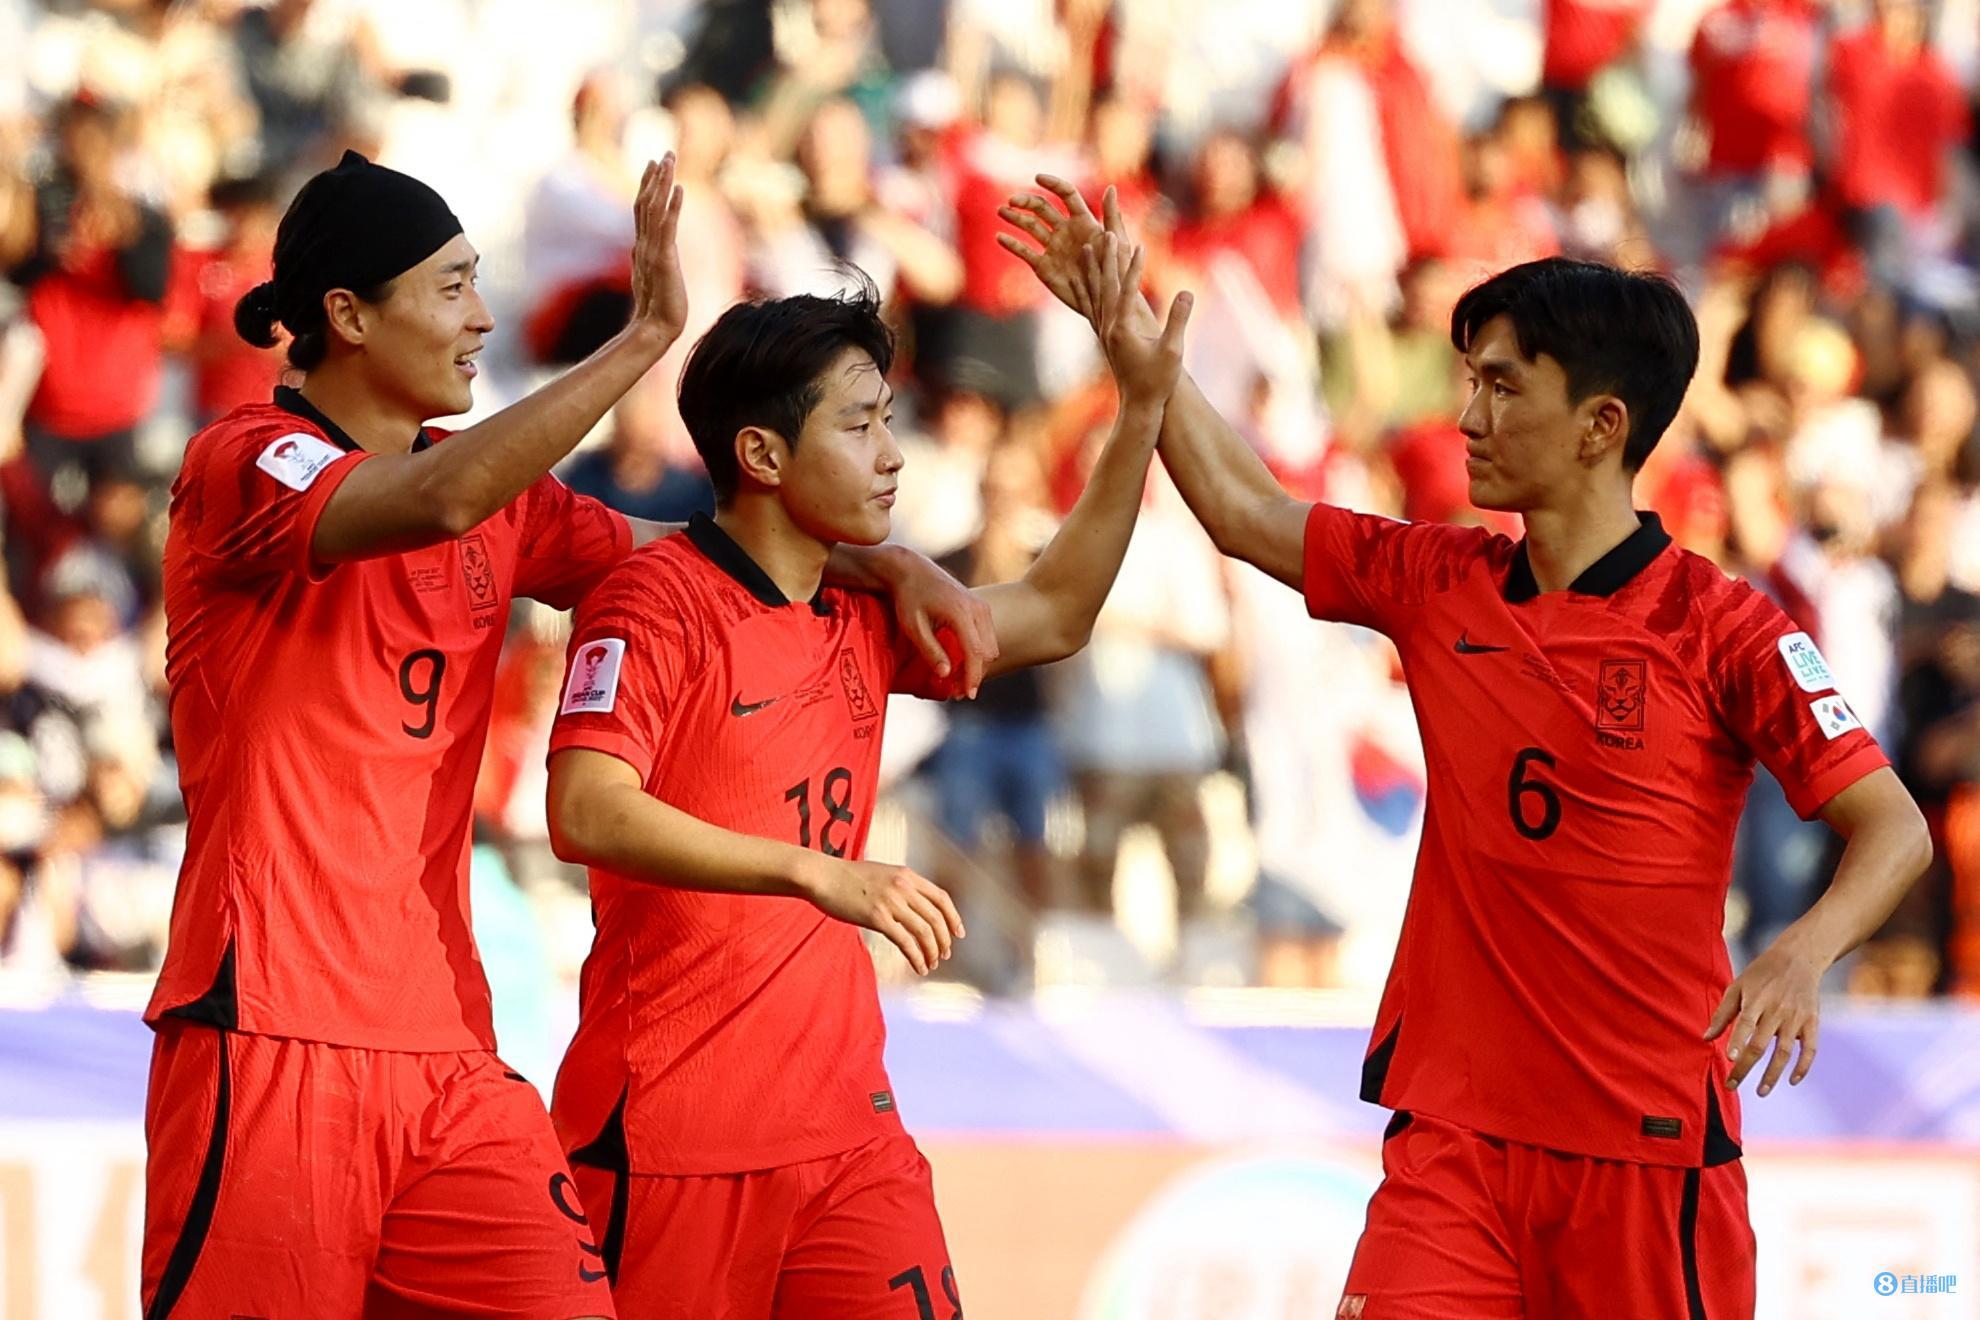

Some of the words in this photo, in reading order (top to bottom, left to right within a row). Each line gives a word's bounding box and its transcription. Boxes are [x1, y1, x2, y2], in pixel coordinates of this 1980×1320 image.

[1789, 642, 1805, 653] AFC
[1791, 651, 1821, 668] LIVE
[400, 648, 446, 738] 9
[1597, 733, 1644, 750] KOREA
[784, 767, 854, 858] 18
[1508, 747, 1561, 841] 6
